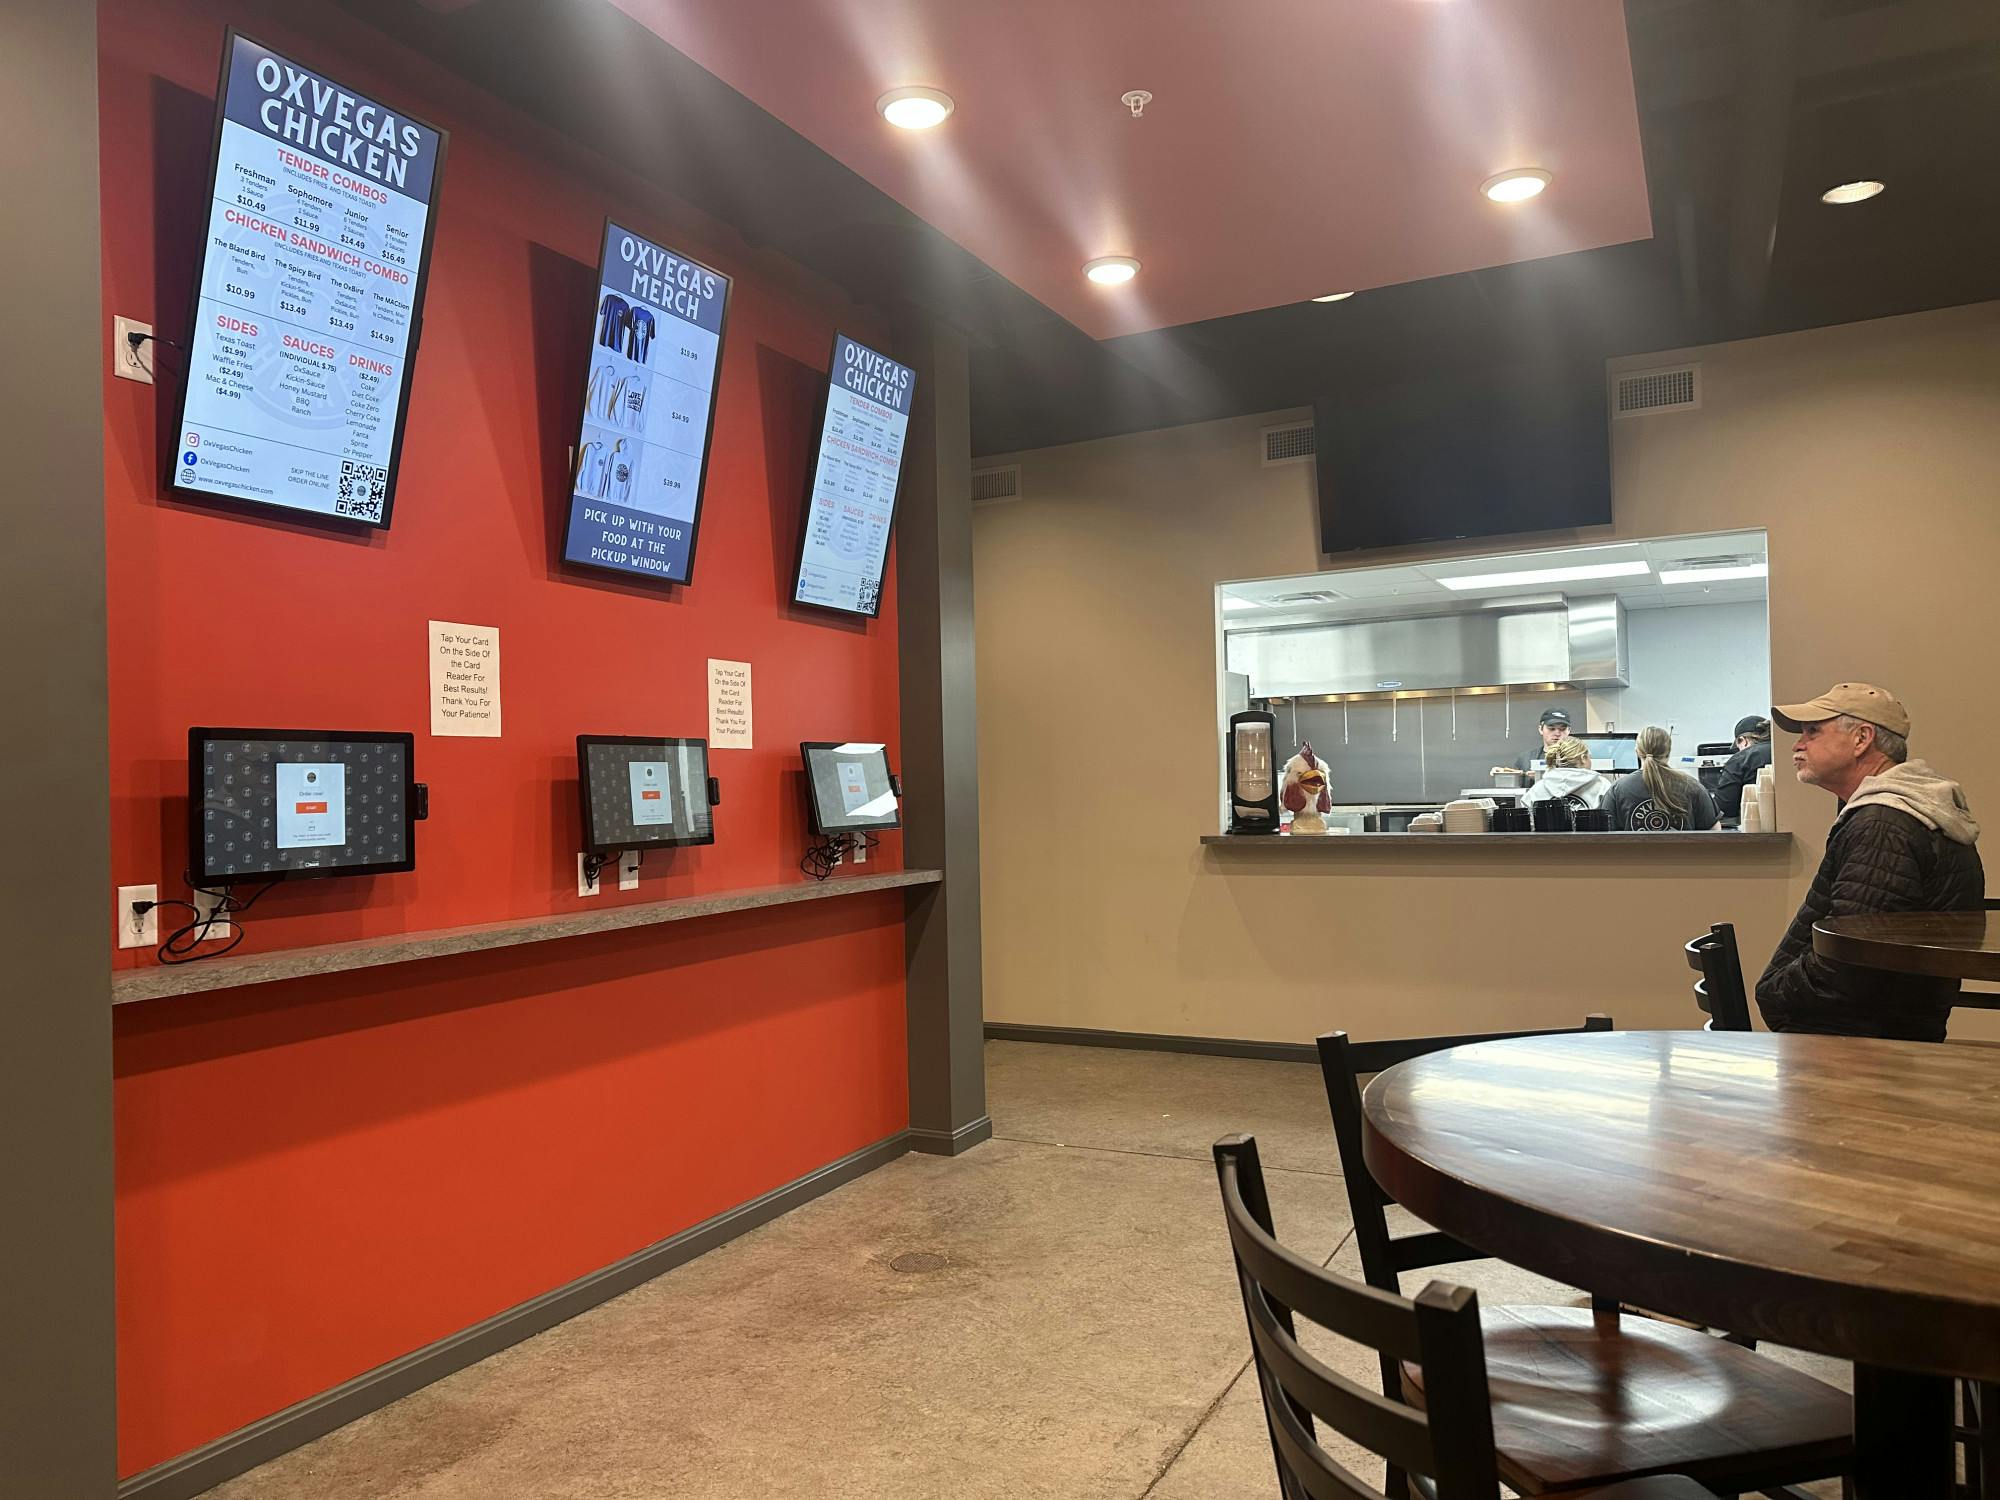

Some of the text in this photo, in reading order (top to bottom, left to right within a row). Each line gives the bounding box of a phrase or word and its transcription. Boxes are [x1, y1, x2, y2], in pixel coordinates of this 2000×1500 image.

[256, 57, 420, 156] OXVEGAS
[260, 98, 407, 188] CHICKEN
[234, 162, 275, 186] Freshman
[277, 148, 387, 204] TENDER COMBOS
[236, 194, 265, 211] $10.49
[287, 184, 333, 208] Sophomore
[344, 208, 368, 222] Junior
[293, 216, 319, 232] $11.99
[386, 224, 408, 238] Senior
[224, 209, 408, 285] CHICKEN SANDWICH COMBO
[340, 233, 365, 249] $14.49
[214, 237, 265, 261] The Bland Bird
[381, 249, 405, 264] $16.49
[274, 258, 321, 280] The Spicy Bird
[620, 236, 717, 299] OXVEGAS
[225, 283, 255, 299] $10.99
[330, 278, 364, 295] The OxBird
[630, 268, 699, 320] MERCH
[373, 292, 384, 301] The
[279, 300, 306, 315] $13.49
[216, 315, 258, 336] SIDES
[329, 316, 353, 330] $13.49
[215, 332, 255, 350] Texas Toast
[370, 329, 394, 343] $14.99
[221, 345, 246, 358] ($1.99)
[282, 334, 334, 359] SAUCES
[212, 353, 252, 370] Waffle Fries
[279, 350, 320, 367] (INDIVIDUAL
[349, 354, 392, 376] DRINKS
[844, 343, 908, 388] OXVEGAS
[219, 366, 243, 379] ($2.49)
[293, 364, 320, 378] OxSauce
[358, 372, 379, 383] ($2.49)
[205, 373, 253, 392] Mac & Cheese
[360, 382, 375, 392] Coke
[844, 366, 902, 408] CHICKEN
[215, 387, 240, 399] ($4.99)
[279, 382, 327, 400] Honey Mustard
[351, 389, 379, 402] Diet Coke
[295, 396, 310, 407] BBQ
[350, 399, 379, 412] Coke Zero
[849, 395, 870, 410] TENDER
[291, 405, 311, 416] Ranch
[344, 408, 380, 422] Cherry Coke
[345, 418, 376, 431] Lemonade
[352, 429, 368, 439] Fanta
[203, 439, 253, 455] OxVegasChicken
[350, 439, 368, 448] Sprite
[343, 446, 373, 459] Dr Pepper
[200, 457, 250, 473] OxVegasChicken
[287, 475, 308, 484] ORDER
[316, 472, 328, 480] LINE
[584, 508, 681, 540] PICK UP WITH YOUR
[601, 530, 665, 554] FOOD AT THE
[591, 546, 671, 572] PICKUP WINDOW
[441, 633, 489, 646] Tap Your Card
[440, 646, 491, 658] On the Side Of
[451, 660, 481, 670] the Card
[446, 671, 485, 682] Reader For
[715, 668, 723, 677] Tap
[734, 670, 745, 678] Card
[443, 684, 488, 695] Best Results!
[730, 679, 740, 687] Side
[740, 680, 746, 688] Of
[729, 689, 740, 697] Card
[441, 696, 491, 707] Thank You For
[441, 709, 491, 719] Your Patience!
